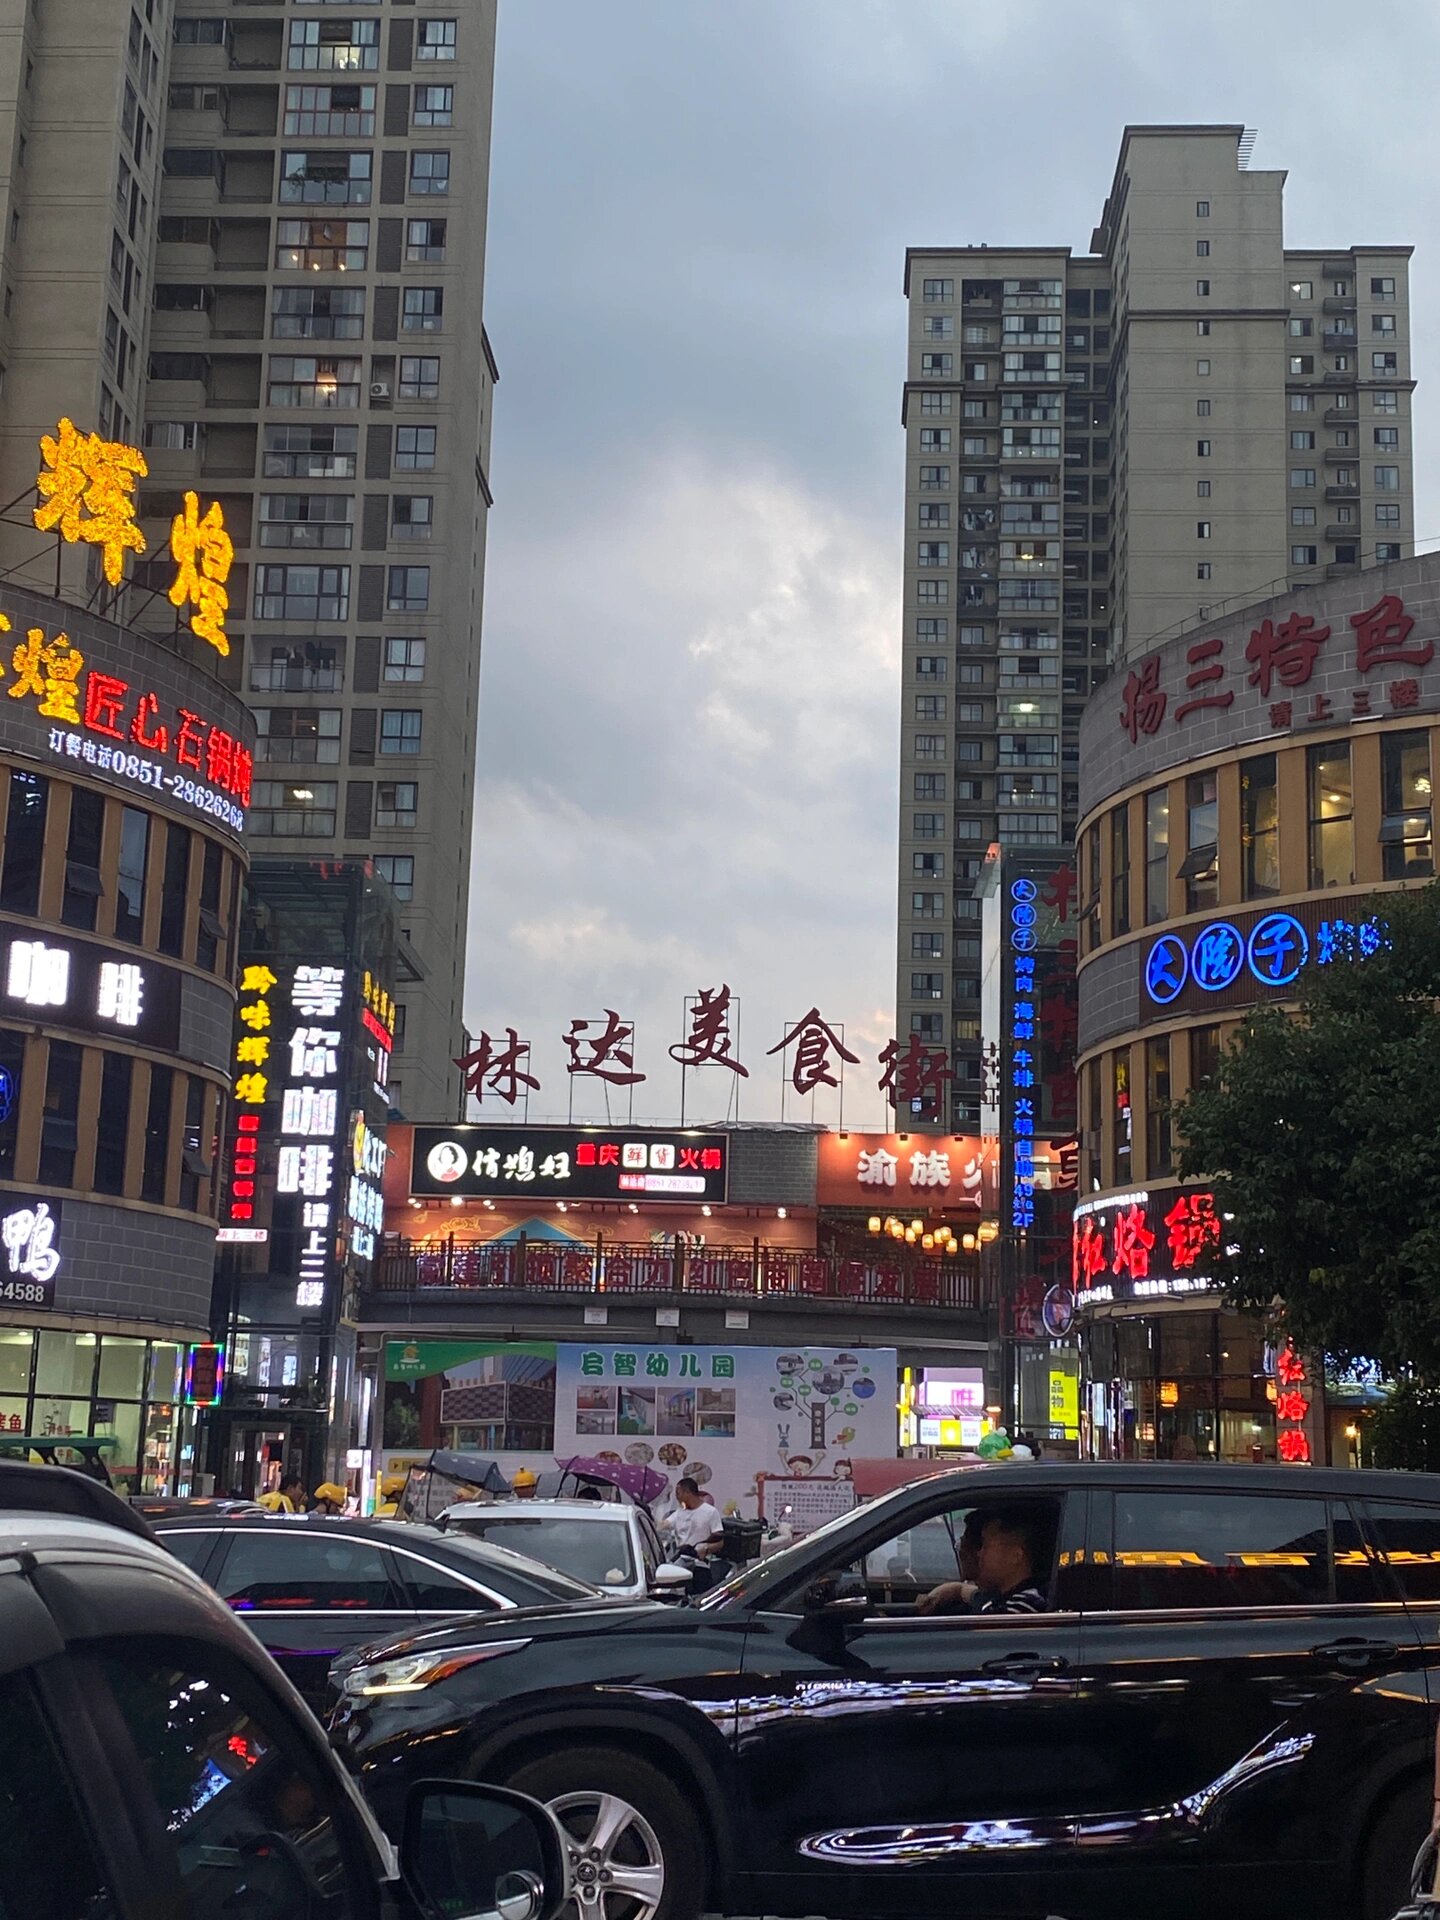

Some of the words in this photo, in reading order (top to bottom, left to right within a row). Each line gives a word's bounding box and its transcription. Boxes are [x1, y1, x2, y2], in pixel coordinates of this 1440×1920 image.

[33, 417, 234, 657] 辉煌
[1269, 678, 1420, 729] 请上三楼
[1011, 879, 1037, 952] 大院子
[8, 940, 144, 1026] 咖啡
[1014, 956, 1034, 993] 烤肉
[1147, 914, 1309, 1003] 大院子
[235, 965, 278, 1103] 黔味辉煌
[454, 984, 956, 1117] 林达美食街
[1013, 1002, 1034, 1040] 海鲜
[277, 965, 344, 1196] 等你咖啡
[1013, 1050, 1034, 1088] 牛排
[472, 1146, 571, 1182] 俏媳妇
[576, 1142, 721, 1170] 重庆鲜货火锅
[1013, 1098, 1035, 1178] 火锅自助
[1012, 1211, 1035, 1228] 2F
[1013, 1183, 1034, 1197] 49
[2, 1203, 61, 1281] 鸭
[296, 1202, 330, 1306] 请上二楼
[580, 1351, 737, 1379] 启智幼儿园
